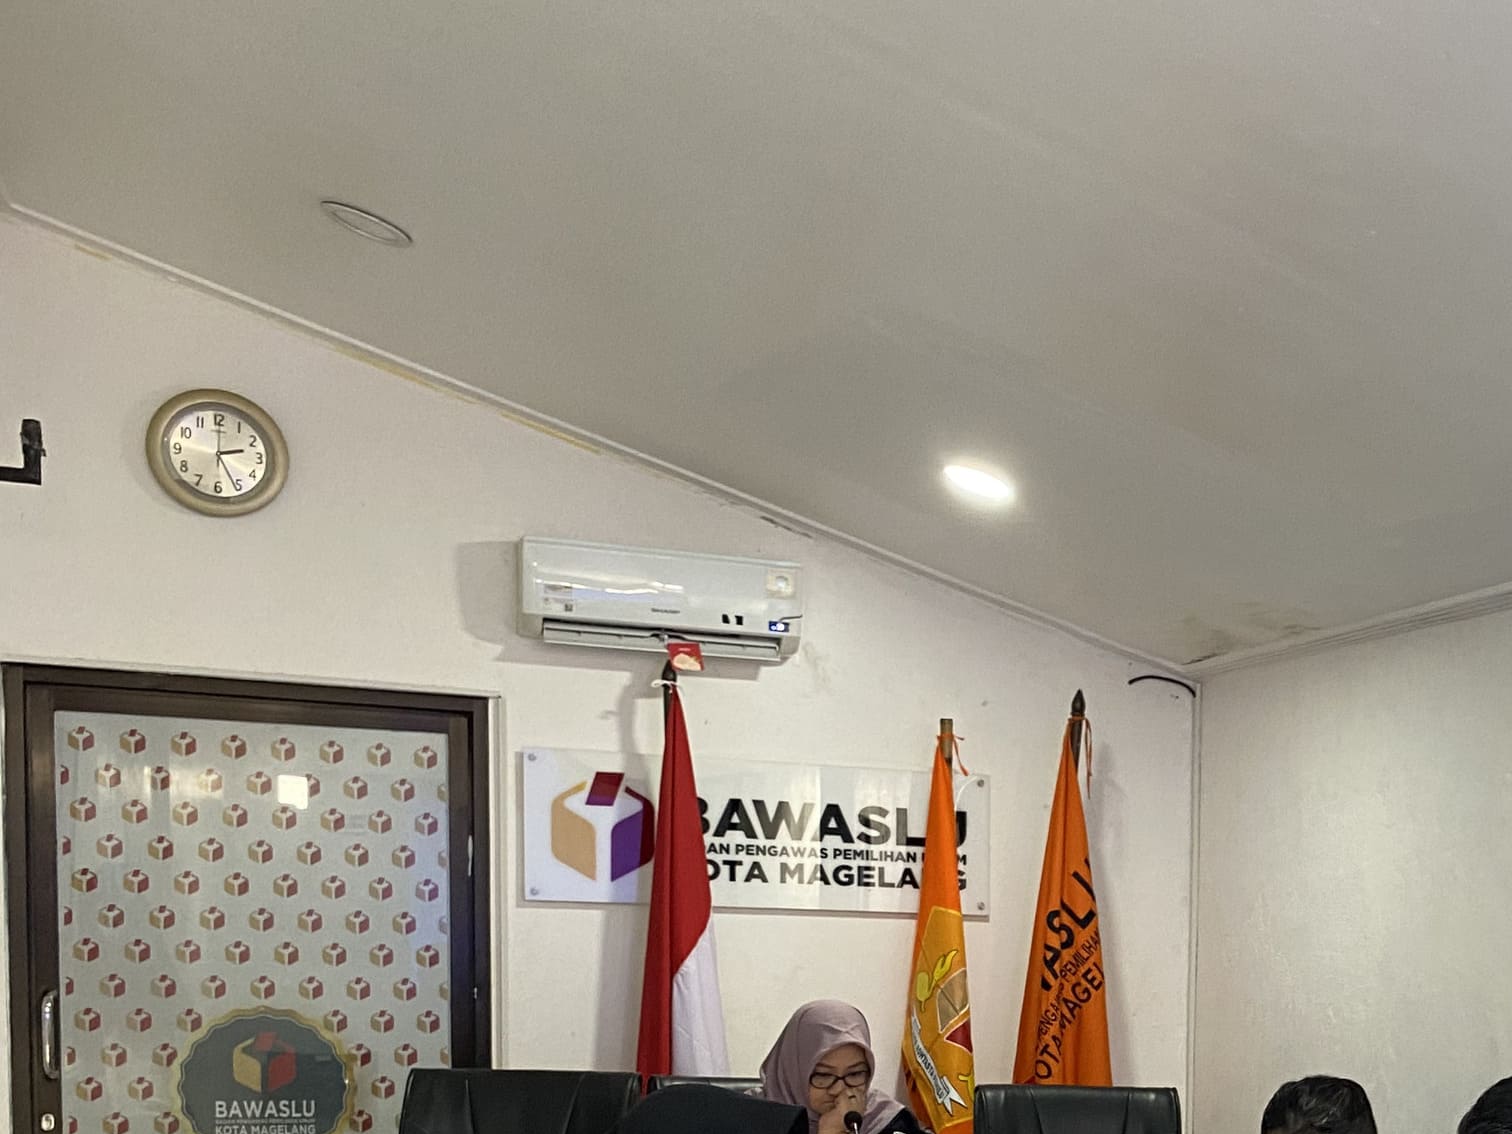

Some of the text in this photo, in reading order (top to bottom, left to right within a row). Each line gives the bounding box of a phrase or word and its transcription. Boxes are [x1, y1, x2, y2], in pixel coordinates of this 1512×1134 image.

[196, 416, 204, 428] 11
[213, 414, 225, 427] 12
[180, 427, 192, 439] 10
[249, 435, 257, 447] 2
[173, 443, 182, 455] 9
[255, 452, 263, 464] 3
[180, 460, 188, 472] 8
[194, 473, 203, 487] 7
[248, 469, 257, 481] 4
[214, 481, 223, 493] 6
[235, 479, 242, 491] 5
[735, 843, 829, 859] PENGAWAS
[833, 847, 917, 863] PEMILIHAN
[706, 858, 967, 891] OTA MAGELA
[1060, 929, 1100, 983] PEMILIHA
[1035, 1034, 1062, 1079] OTA
[215, 1100, 316, 1118] BAWASLU
